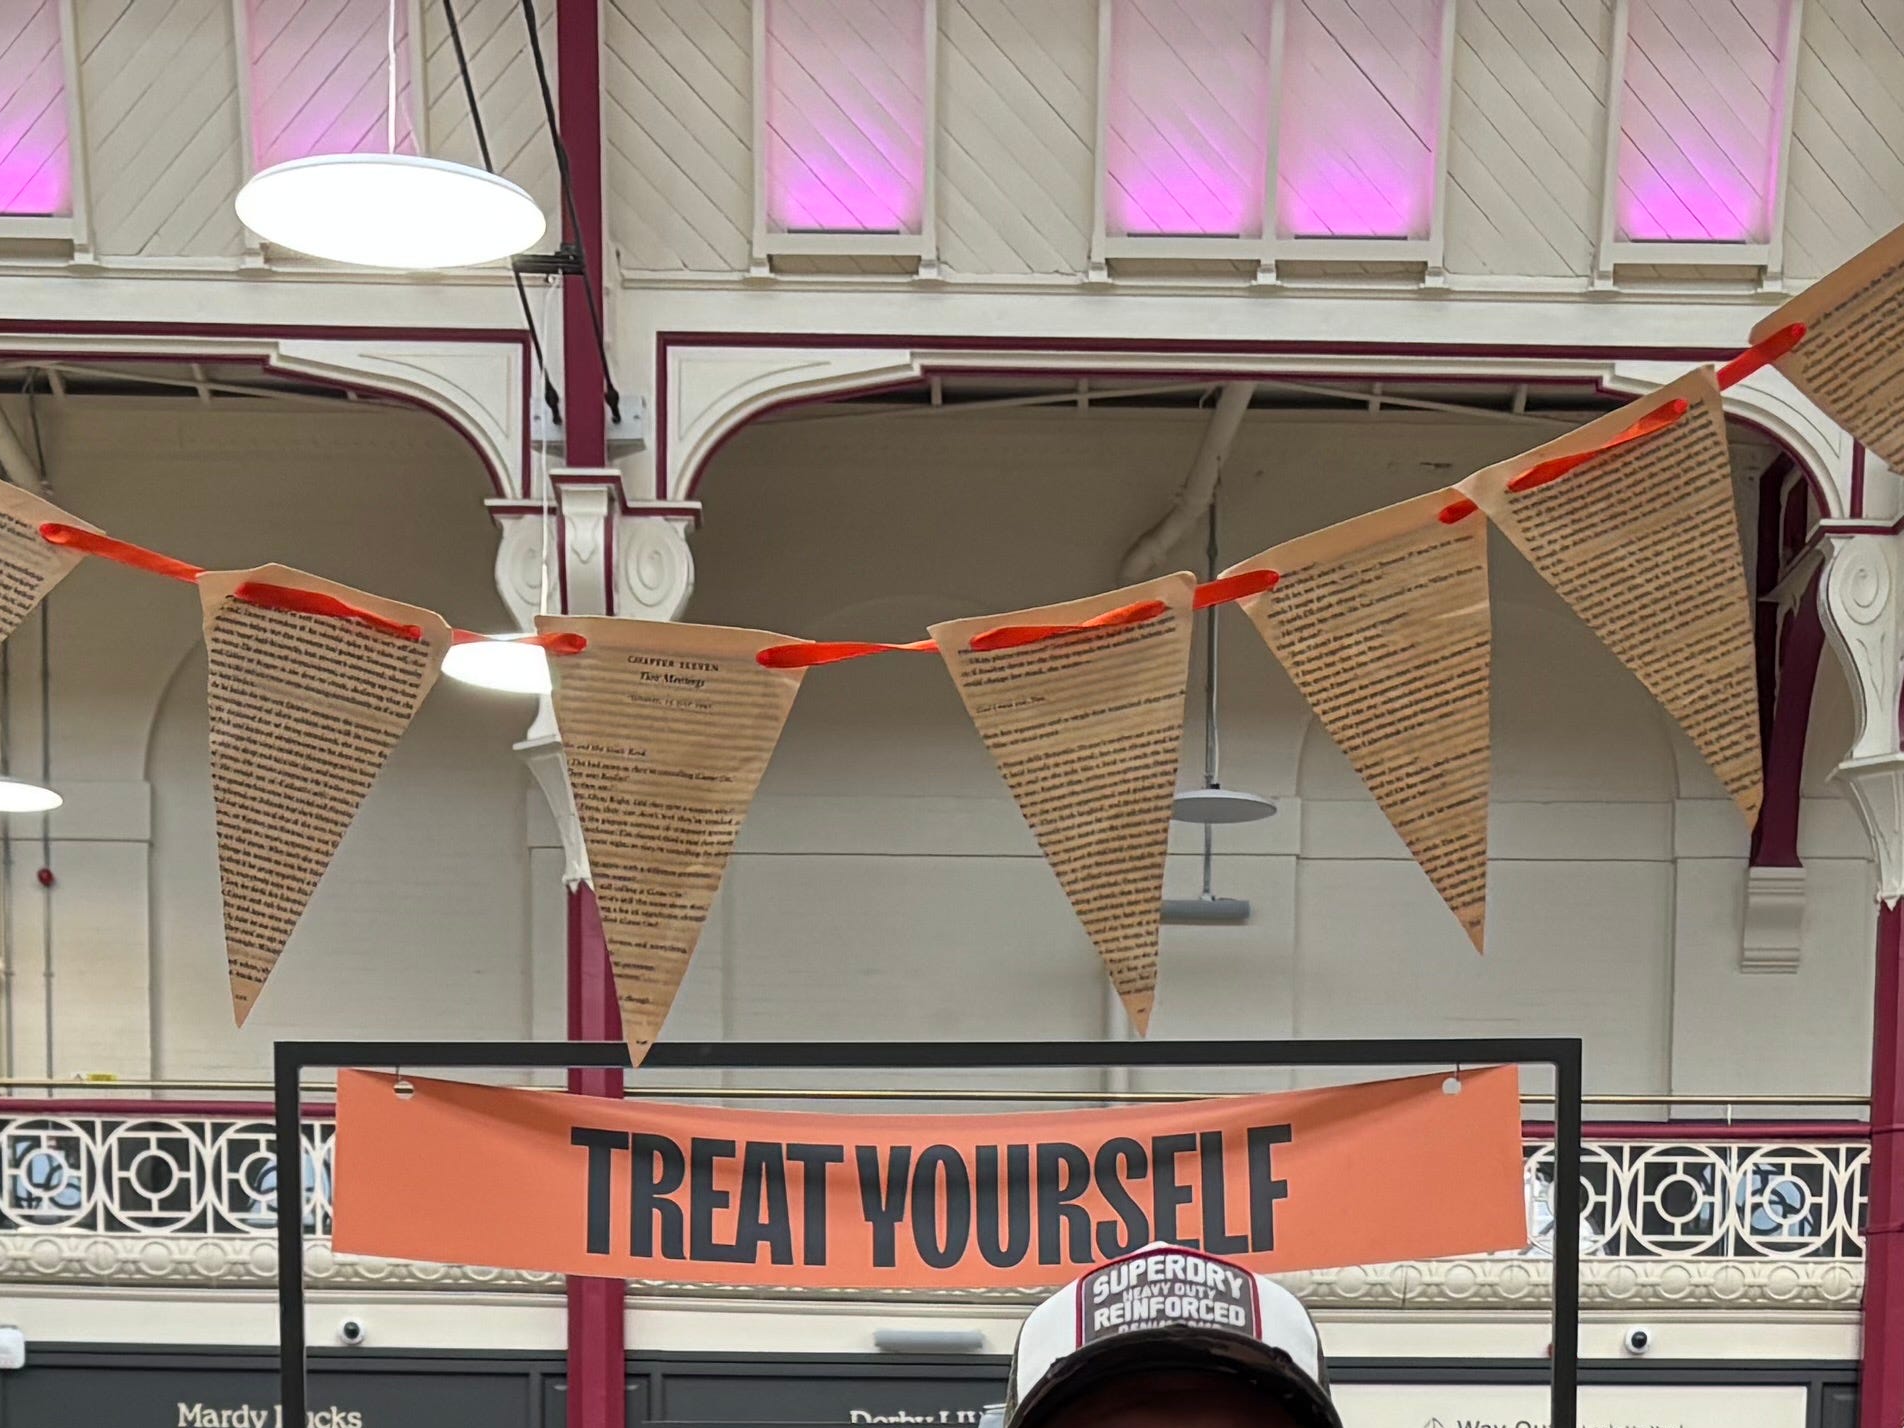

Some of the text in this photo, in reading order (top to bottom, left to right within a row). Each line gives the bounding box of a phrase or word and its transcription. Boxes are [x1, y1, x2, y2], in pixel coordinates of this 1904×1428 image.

[571, 1123, 1293, 1269] TREAT YOURSELF
[1093, 1255, 1243, 1303] SUPERDRY
[1123, 1282, 1216, 1302] HEAVY DUTY
[1094, 1297, 1245, 1331] REINFORCED
